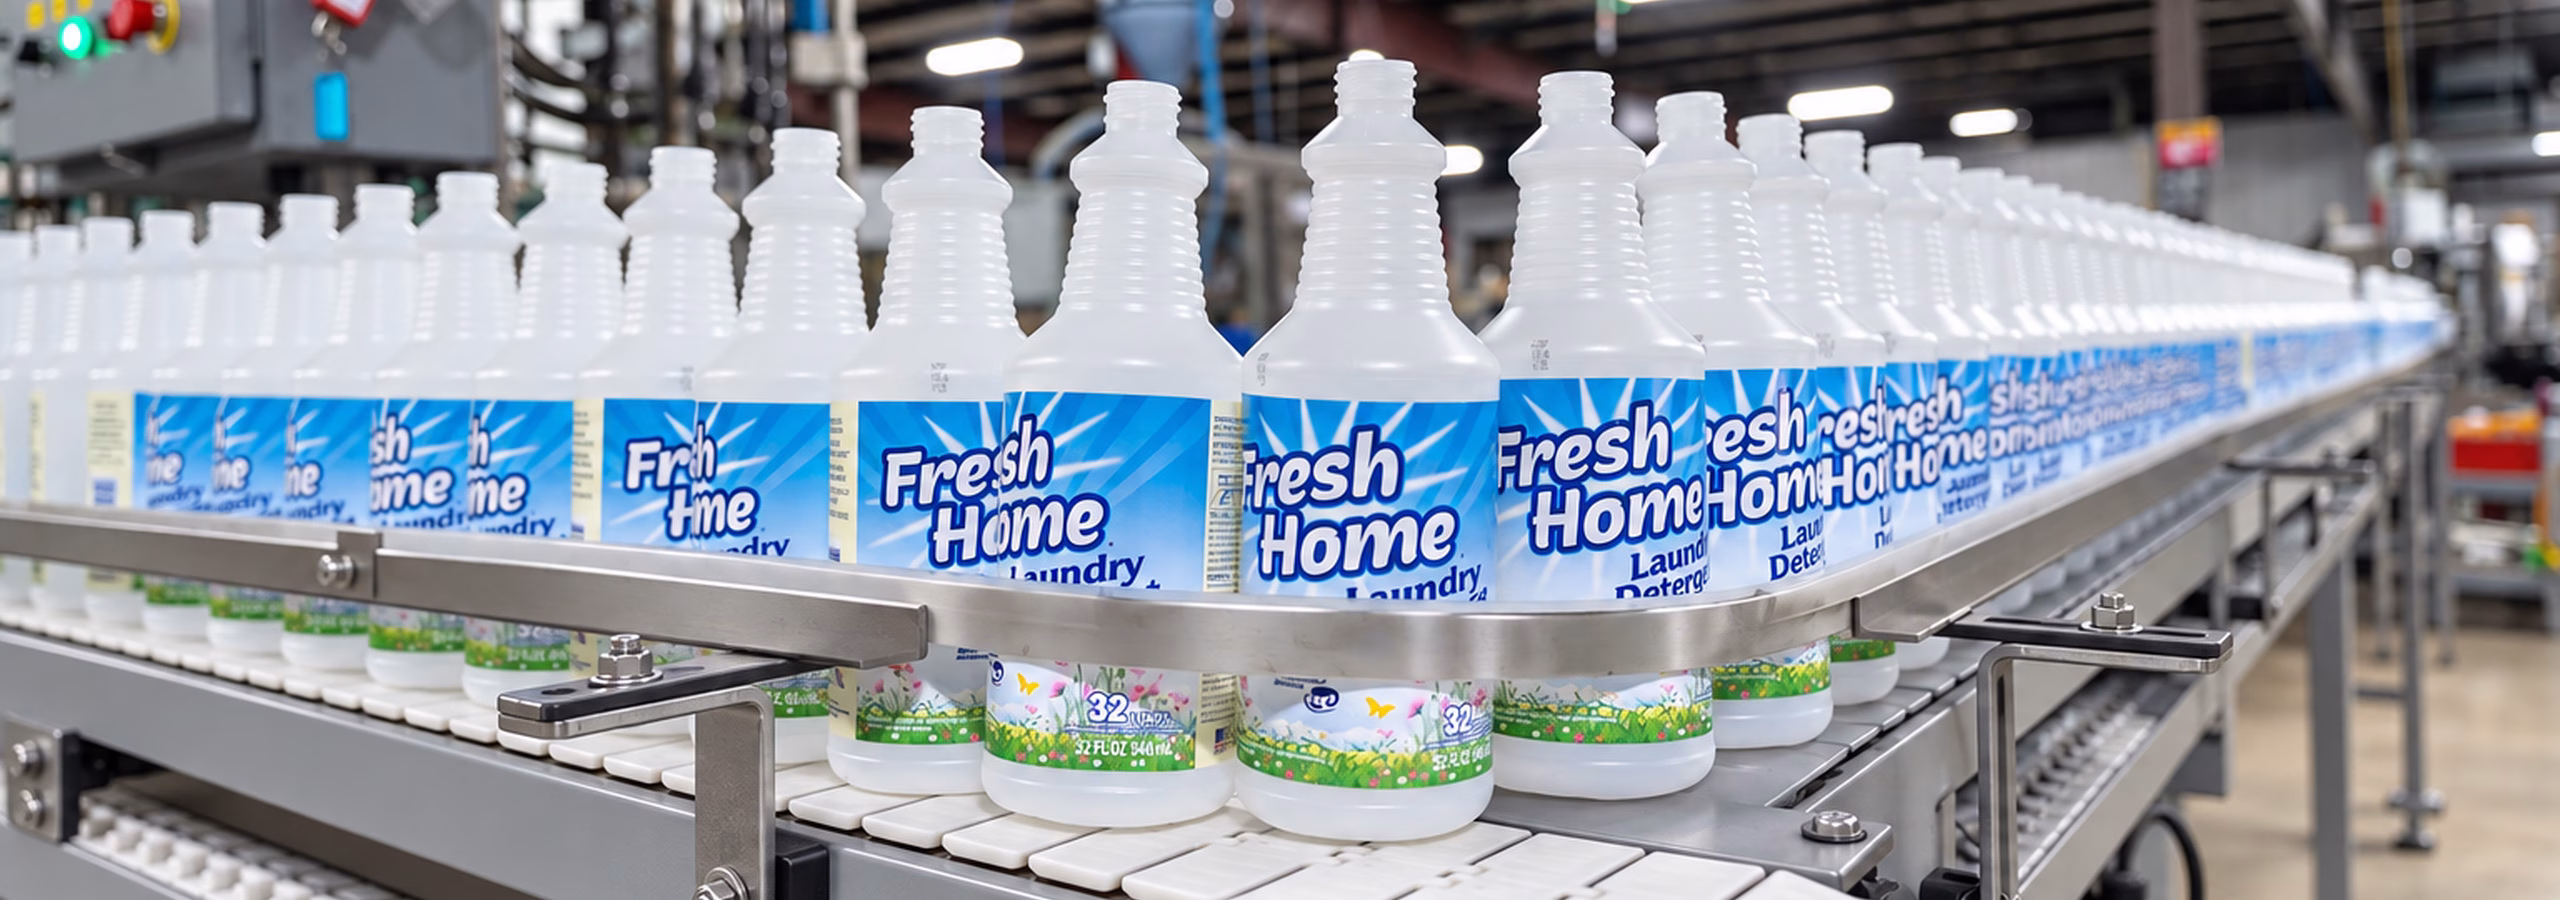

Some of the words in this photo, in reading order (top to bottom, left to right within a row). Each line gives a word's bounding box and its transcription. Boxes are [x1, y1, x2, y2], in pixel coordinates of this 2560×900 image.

[1531, 476, 1703, 552] Home
[1258, 507, 1460, 580] Home
[1086, 691, 1130, 724] 32
[1443, 702, 1473, 738] 32
[1111, 740, 1128, 757] OZ
